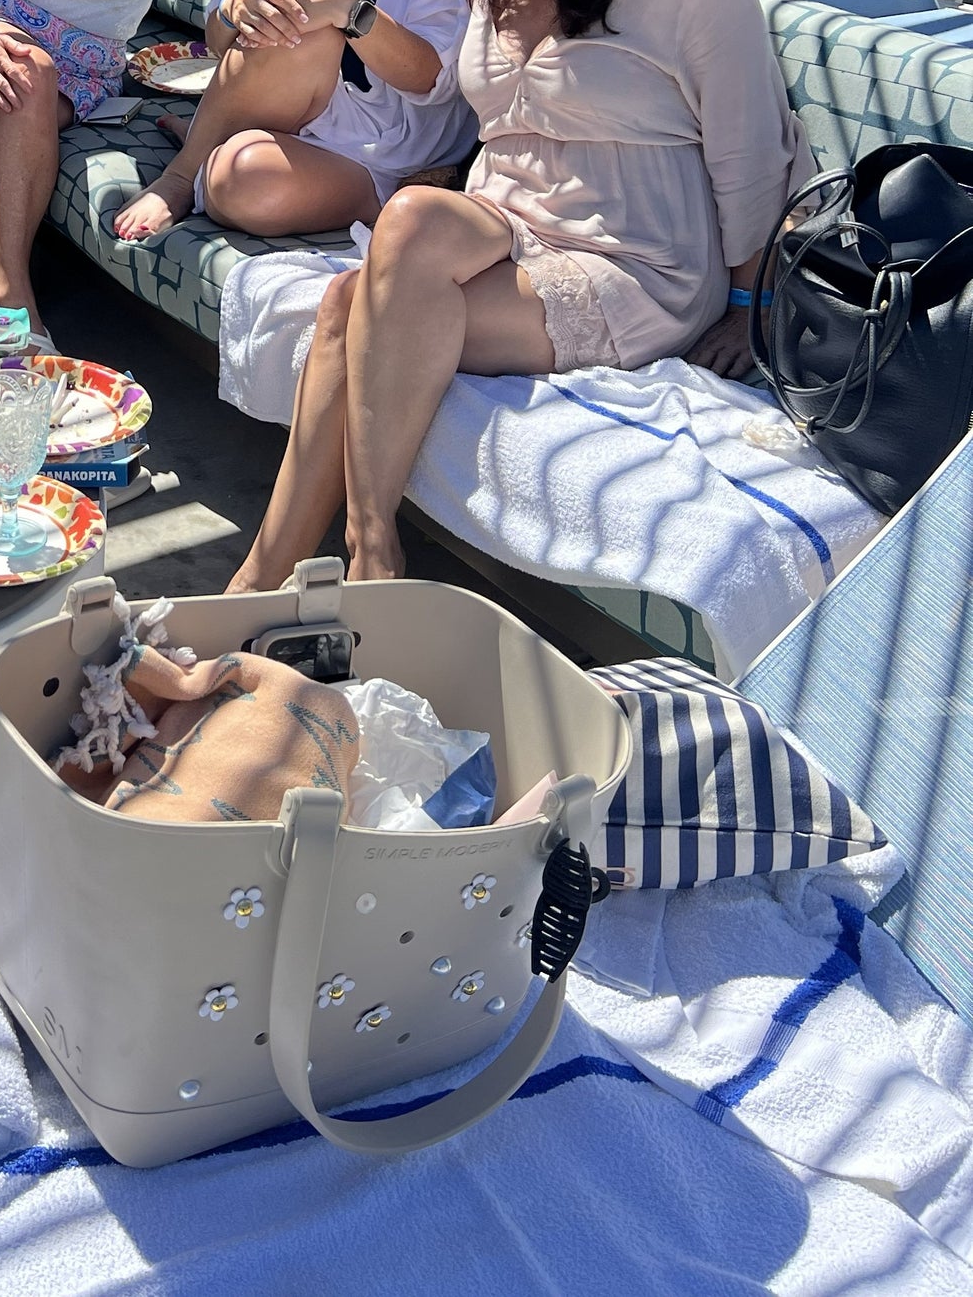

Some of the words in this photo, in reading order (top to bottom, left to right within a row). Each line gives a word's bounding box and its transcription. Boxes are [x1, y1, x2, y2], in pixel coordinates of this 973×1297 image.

[38, 470, 117, 481] ANAKOPITA
[364, 846, 432, 860] SIMPLE
[435, 838, 514, 858] MODERN
